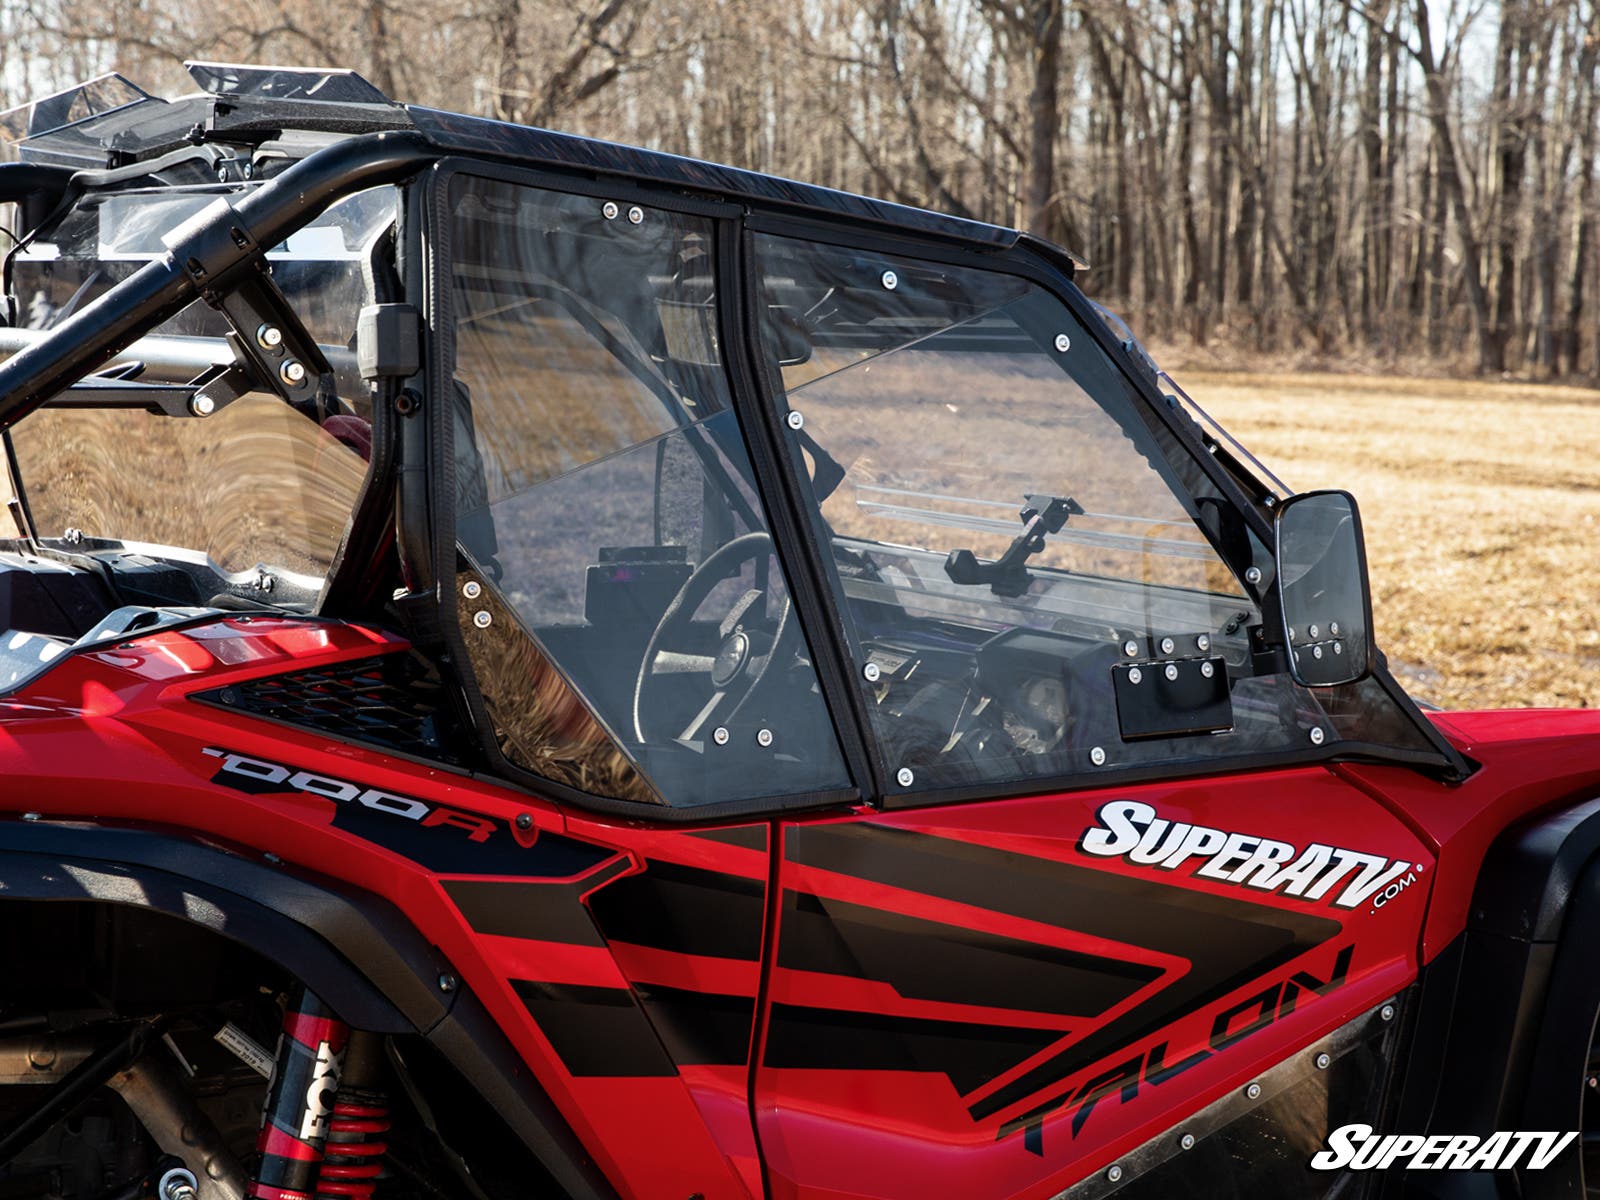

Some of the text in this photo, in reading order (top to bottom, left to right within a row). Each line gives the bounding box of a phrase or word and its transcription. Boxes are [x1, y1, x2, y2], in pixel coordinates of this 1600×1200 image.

[1081, 799, 1411, 909] SUPERATV
[300, 1040, 346, 1141] FOX
[995, 943, 1355, 1158] TALON
